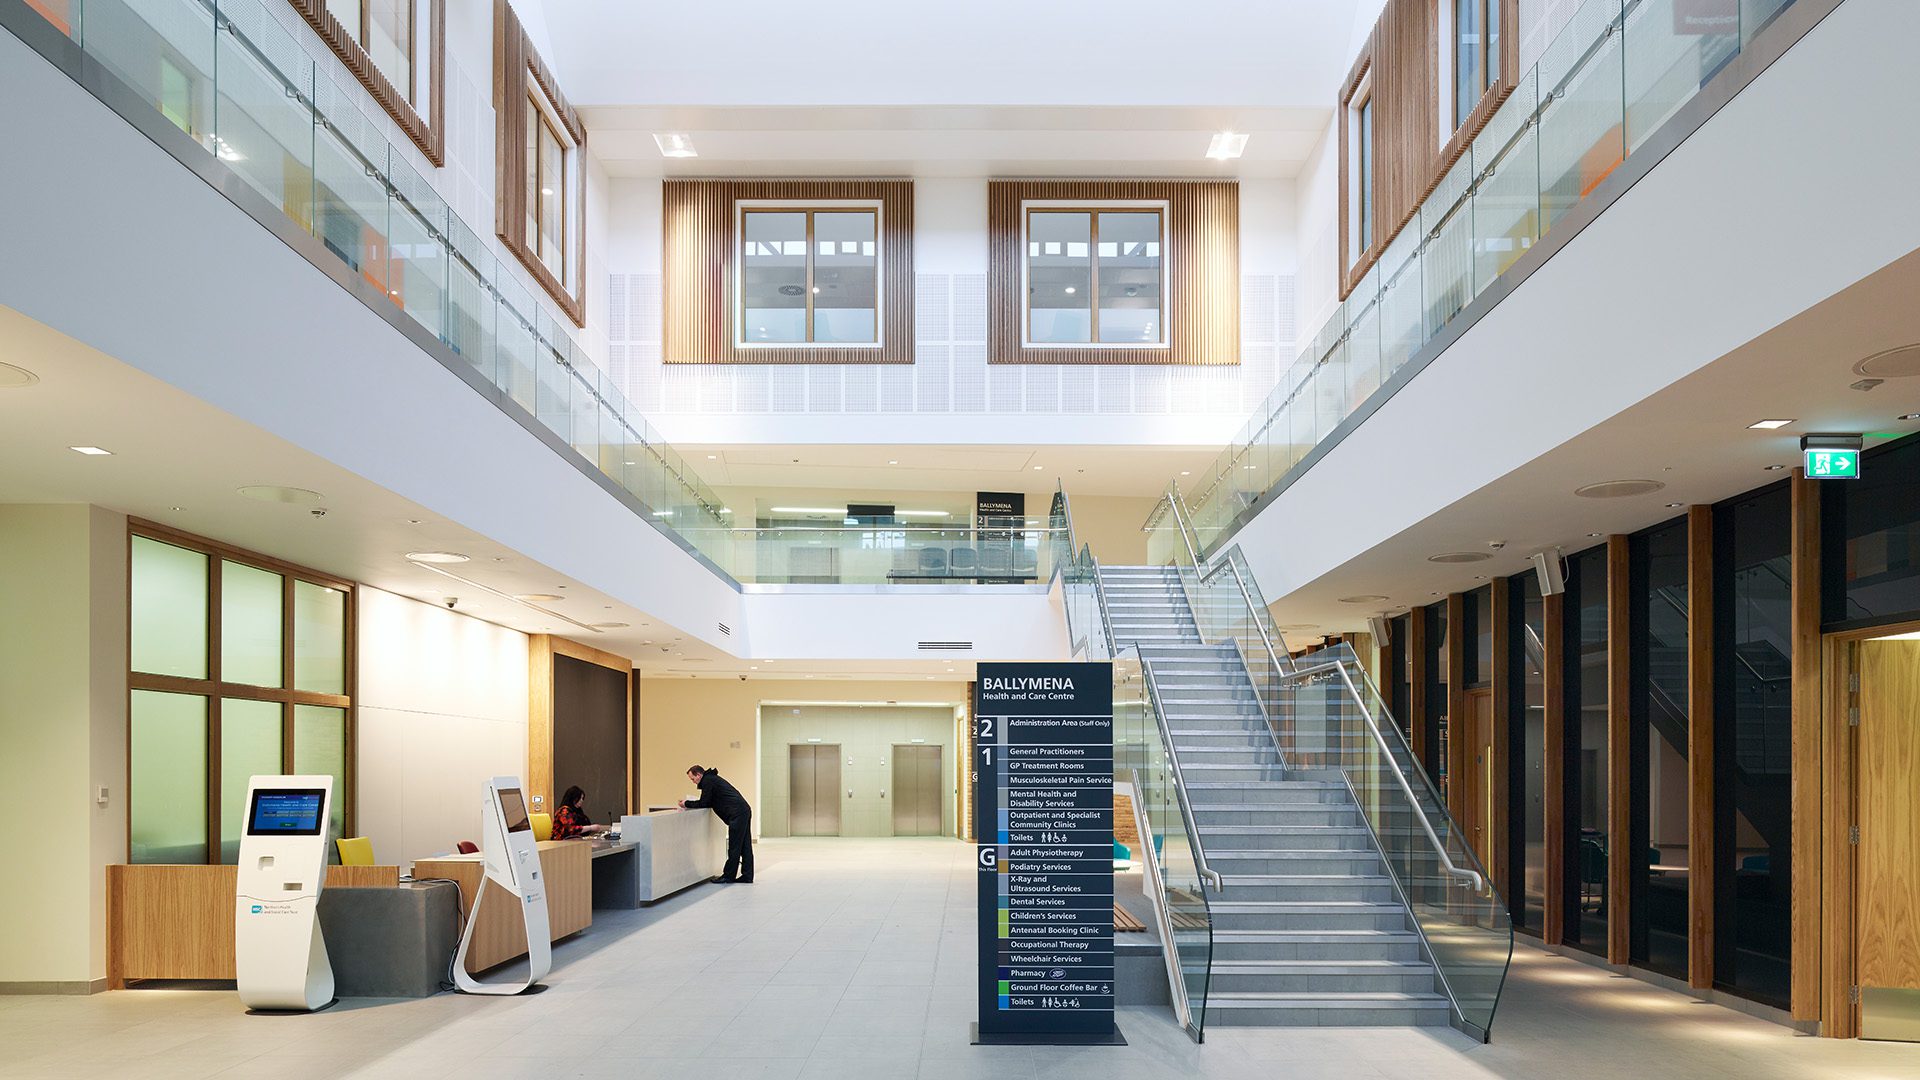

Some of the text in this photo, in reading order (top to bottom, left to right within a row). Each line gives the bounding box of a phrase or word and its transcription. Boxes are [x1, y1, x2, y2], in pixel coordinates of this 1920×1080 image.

[983, 678, 1074, 689] BALLYMENA
[980, 719, 993, 737] 2
[982, 748, 990, 765] 1
[980, 848, 995, 866] G
